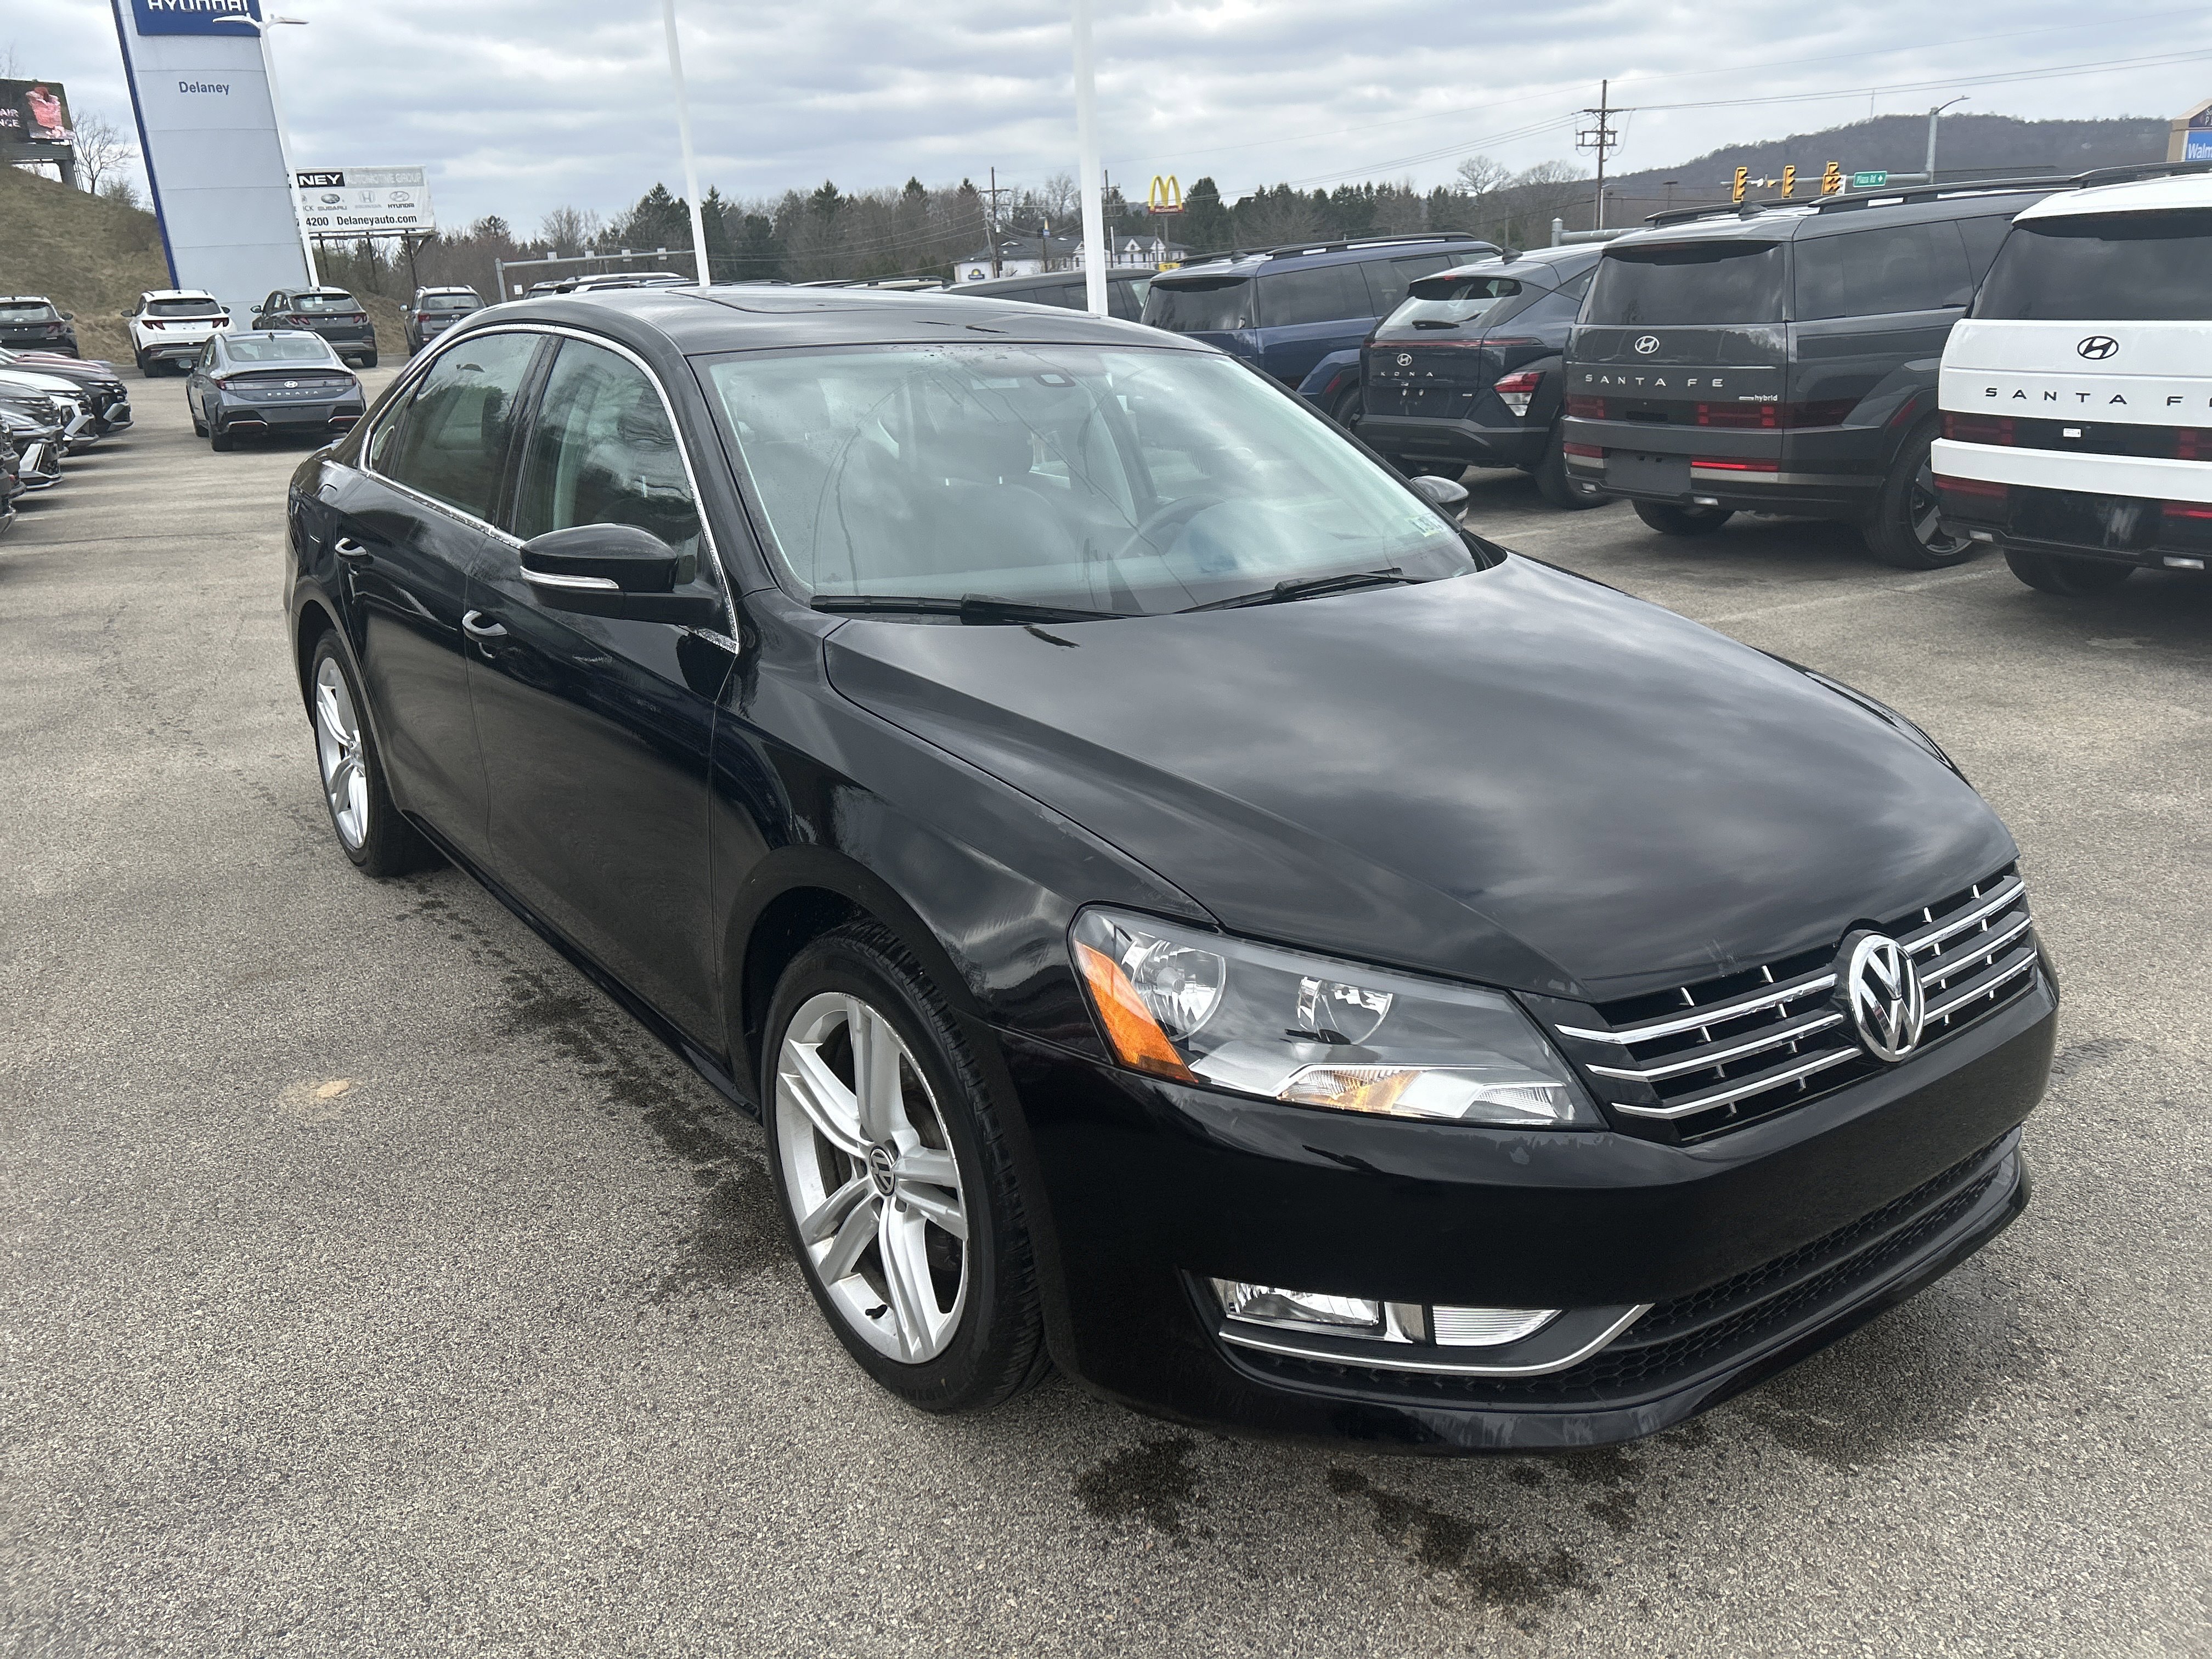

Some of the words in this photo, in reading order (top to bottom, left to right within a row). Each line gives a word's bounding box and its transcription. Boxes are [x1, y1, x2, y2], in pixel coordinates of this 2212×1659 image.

[179, 82, 229, 95] Delaney
[298, 174, 341, 186] NEY
[306, 217, 329, 227] 4200
[336, 215, 417, 226] Delaneyauto.com
[1585, 374, 1666, 386] SANTA
[1687, 378, 1723, 387] FE
[1754, 394, 1778, 403] hybrid
[1985, 387, 2128, 405] SANTA
[2166, 396, 2212, 408] F
